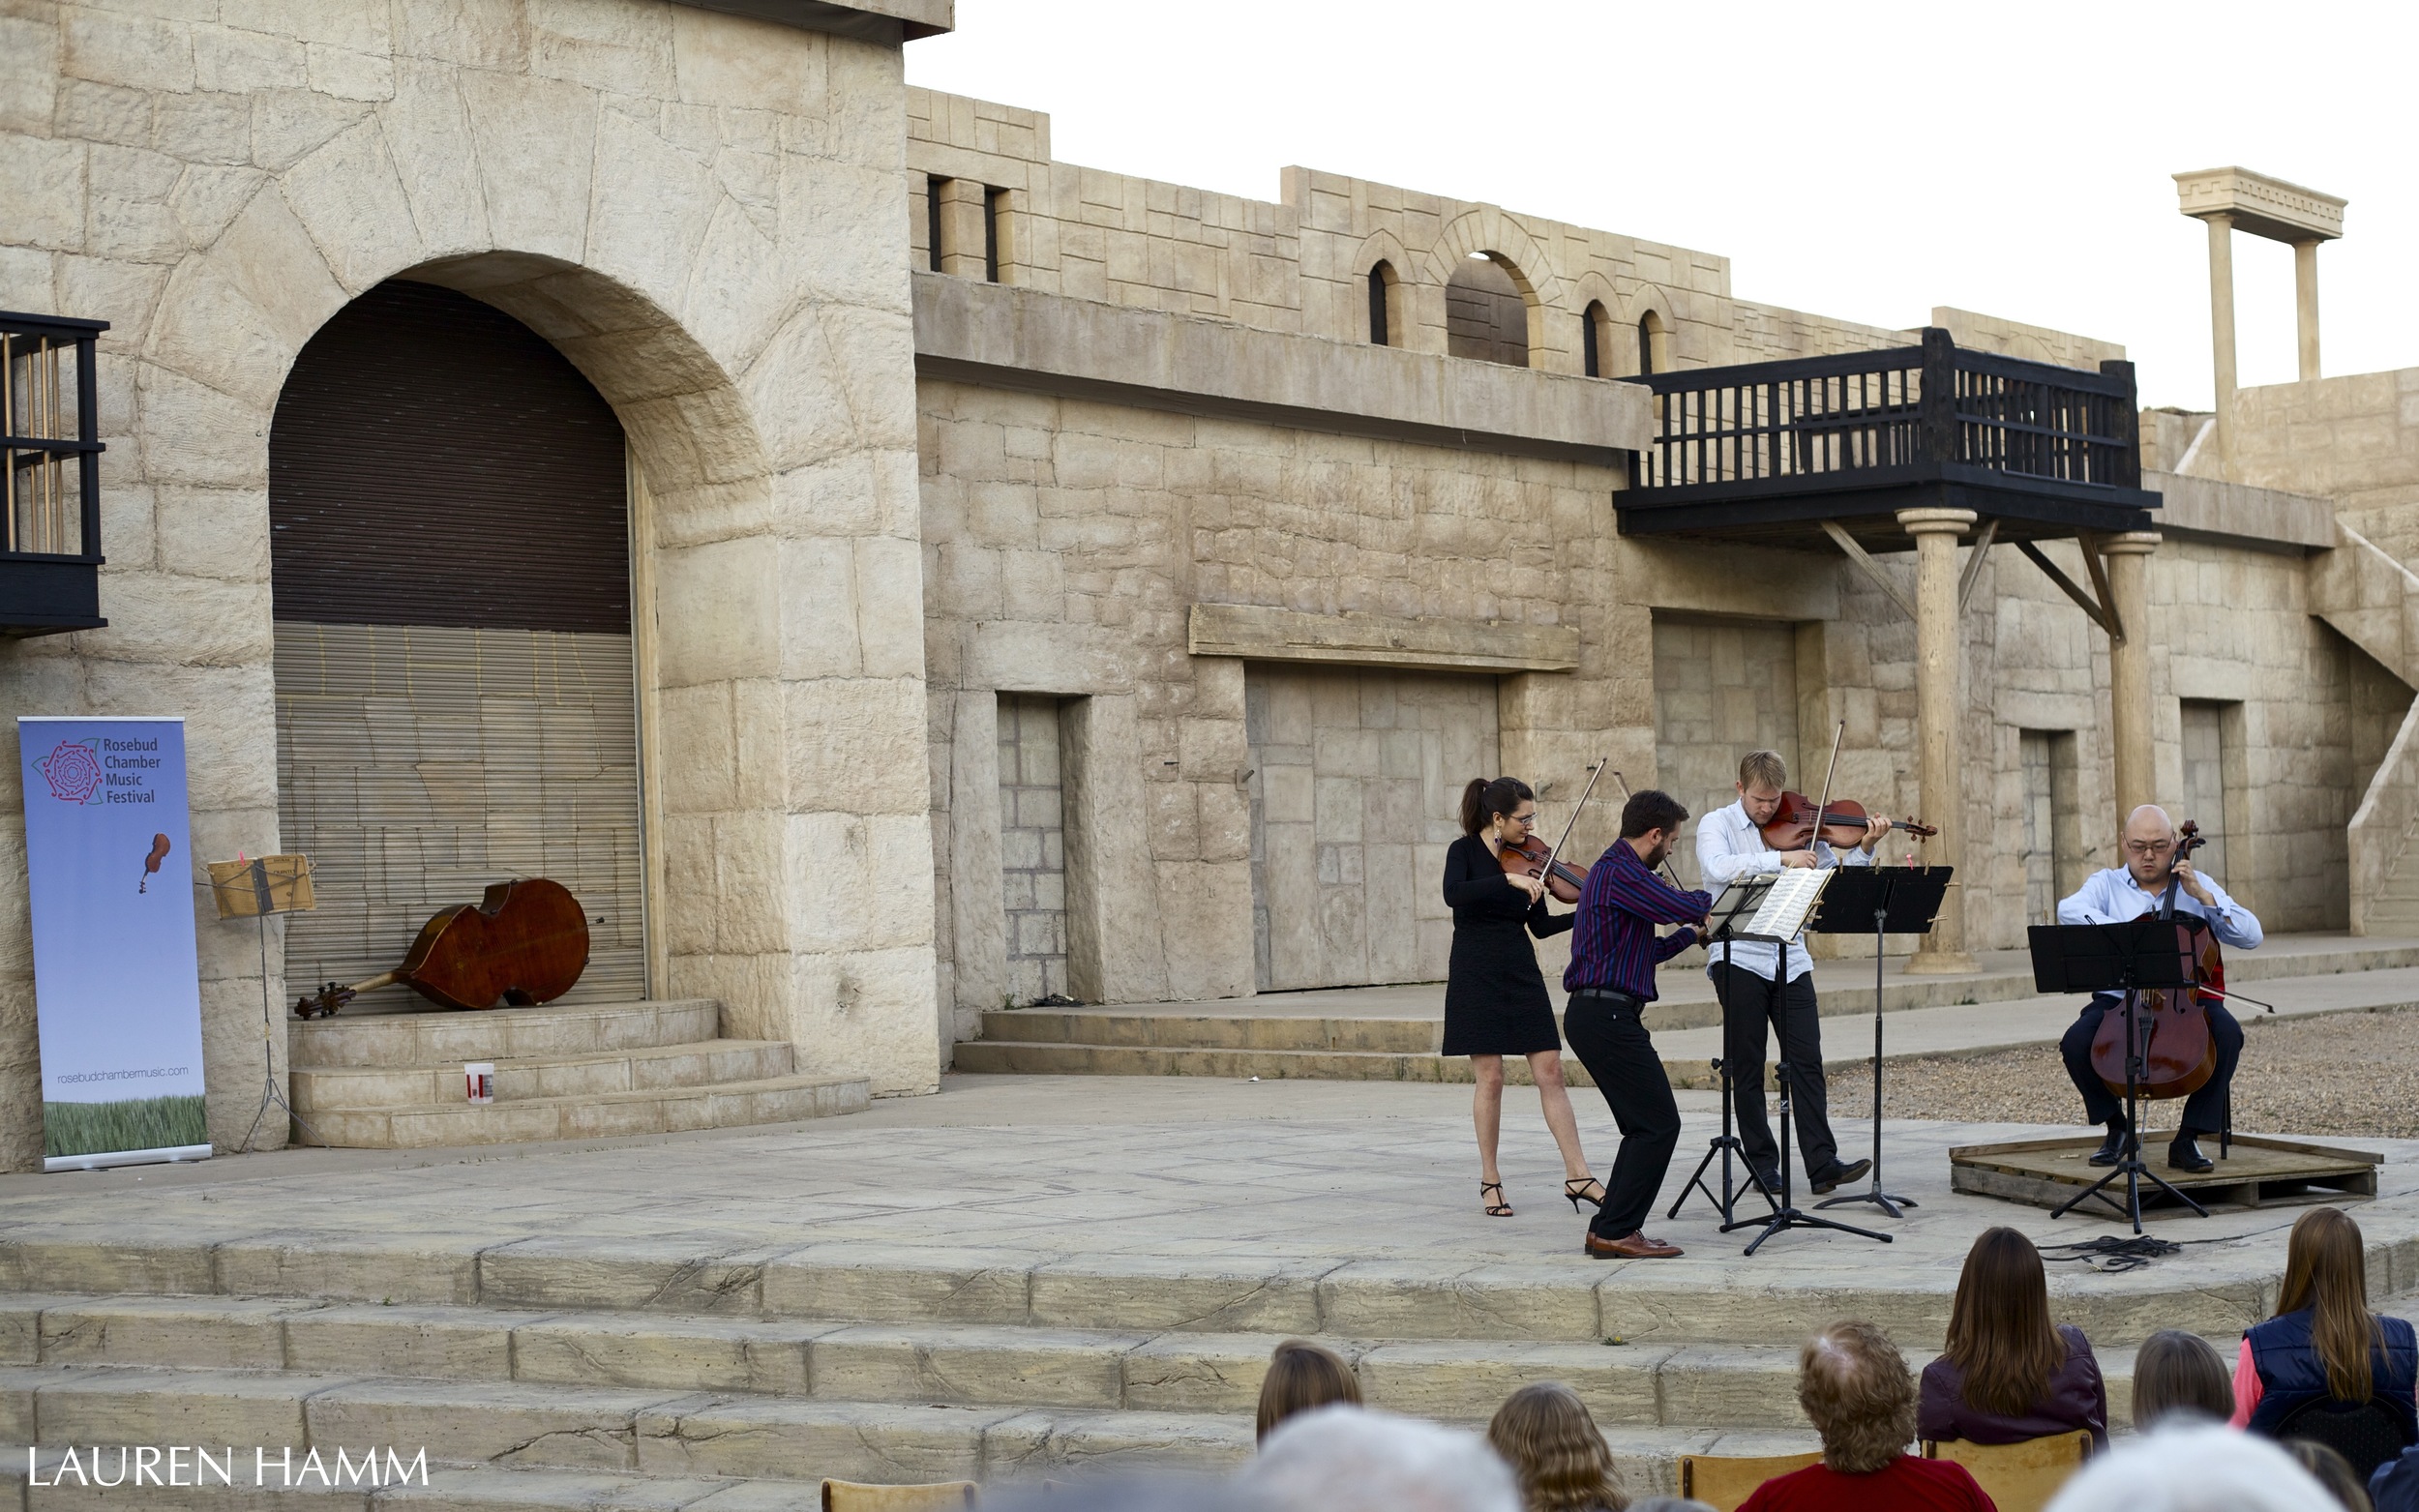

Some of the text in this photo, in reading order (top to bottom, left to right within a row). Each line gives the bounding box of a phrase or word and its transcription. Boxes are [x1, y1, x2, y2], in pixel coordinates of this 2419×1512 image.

[104, 737, 158, 752] Rosebud
[105, 755, 161, 768] Chamber
[105, 772, 142, 786] Music
[106, 788, 155, 803] Festival
[57, 1066, 189, 1083] rosebudchambermusic.com
